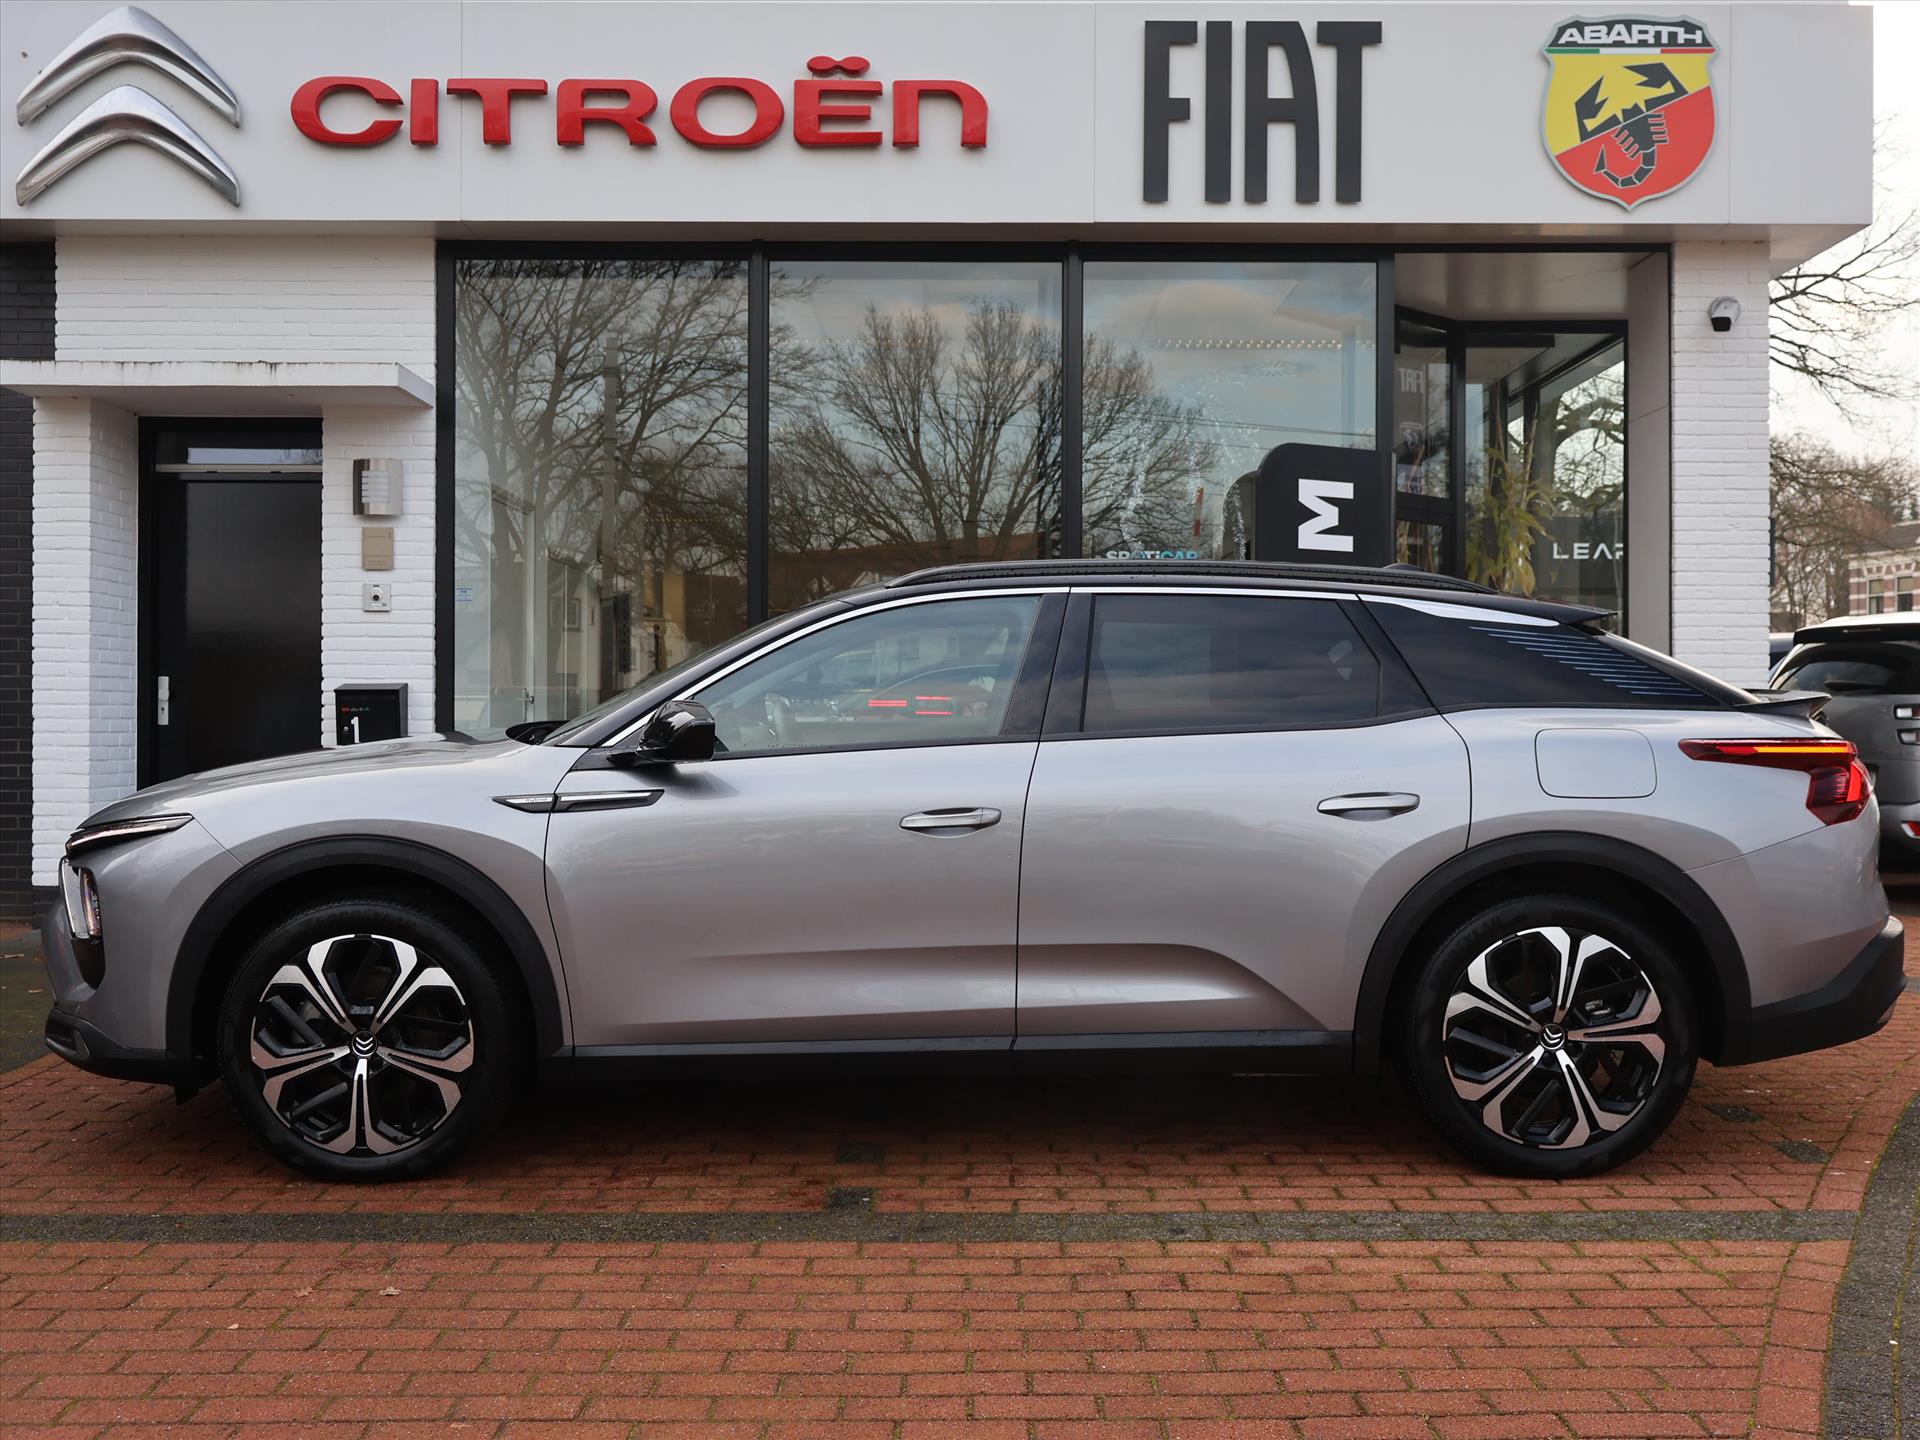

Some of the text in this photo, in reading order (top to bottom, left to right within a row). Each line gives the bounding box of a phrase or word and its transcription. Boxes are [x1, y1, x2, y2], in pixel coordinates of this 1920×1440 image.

[1557, 23, 1702, 44] ABARTH
[1143, 20, 1382, 203] FIAT
[350, 716, 360, 743] 1
